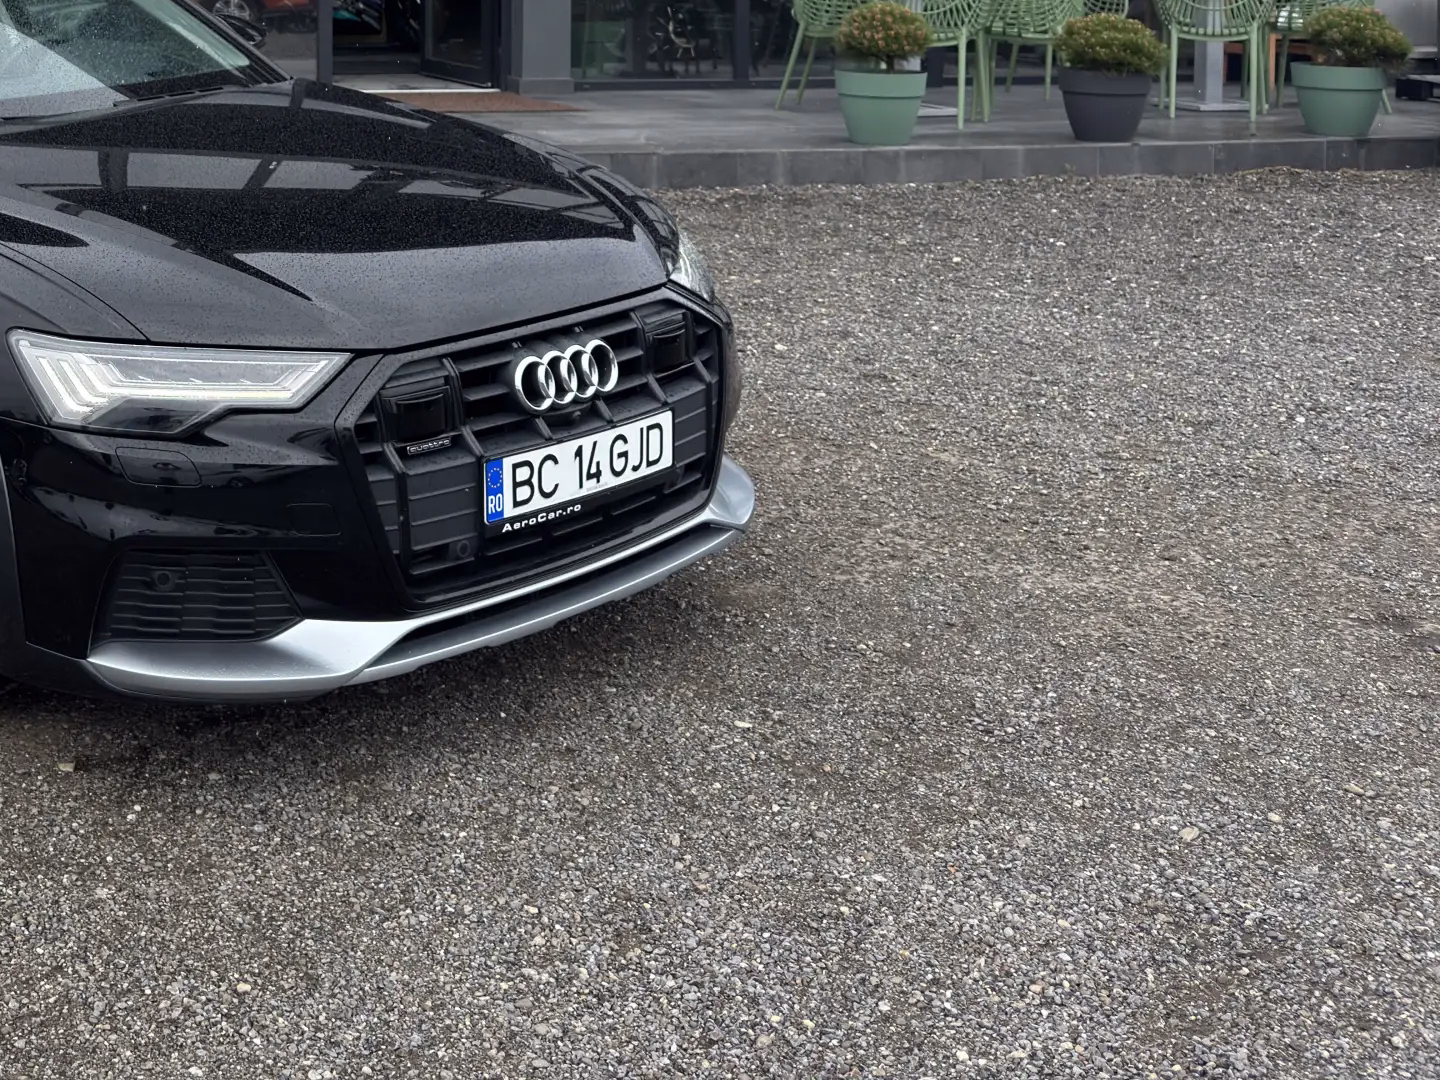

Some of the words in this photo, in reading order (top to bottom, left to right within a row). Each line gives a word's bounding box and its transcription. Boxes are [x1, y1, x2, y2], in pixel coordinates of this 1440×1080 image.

[409, 439, 450, 453] quattro
[511, 453, 559, 509] BC
[573, 440, 602, 490] 14
[609, 422, 663, 478] GJD
[487, 493, 503, 515] RO
[501, 503, 582, 533] AeroCar.ro
